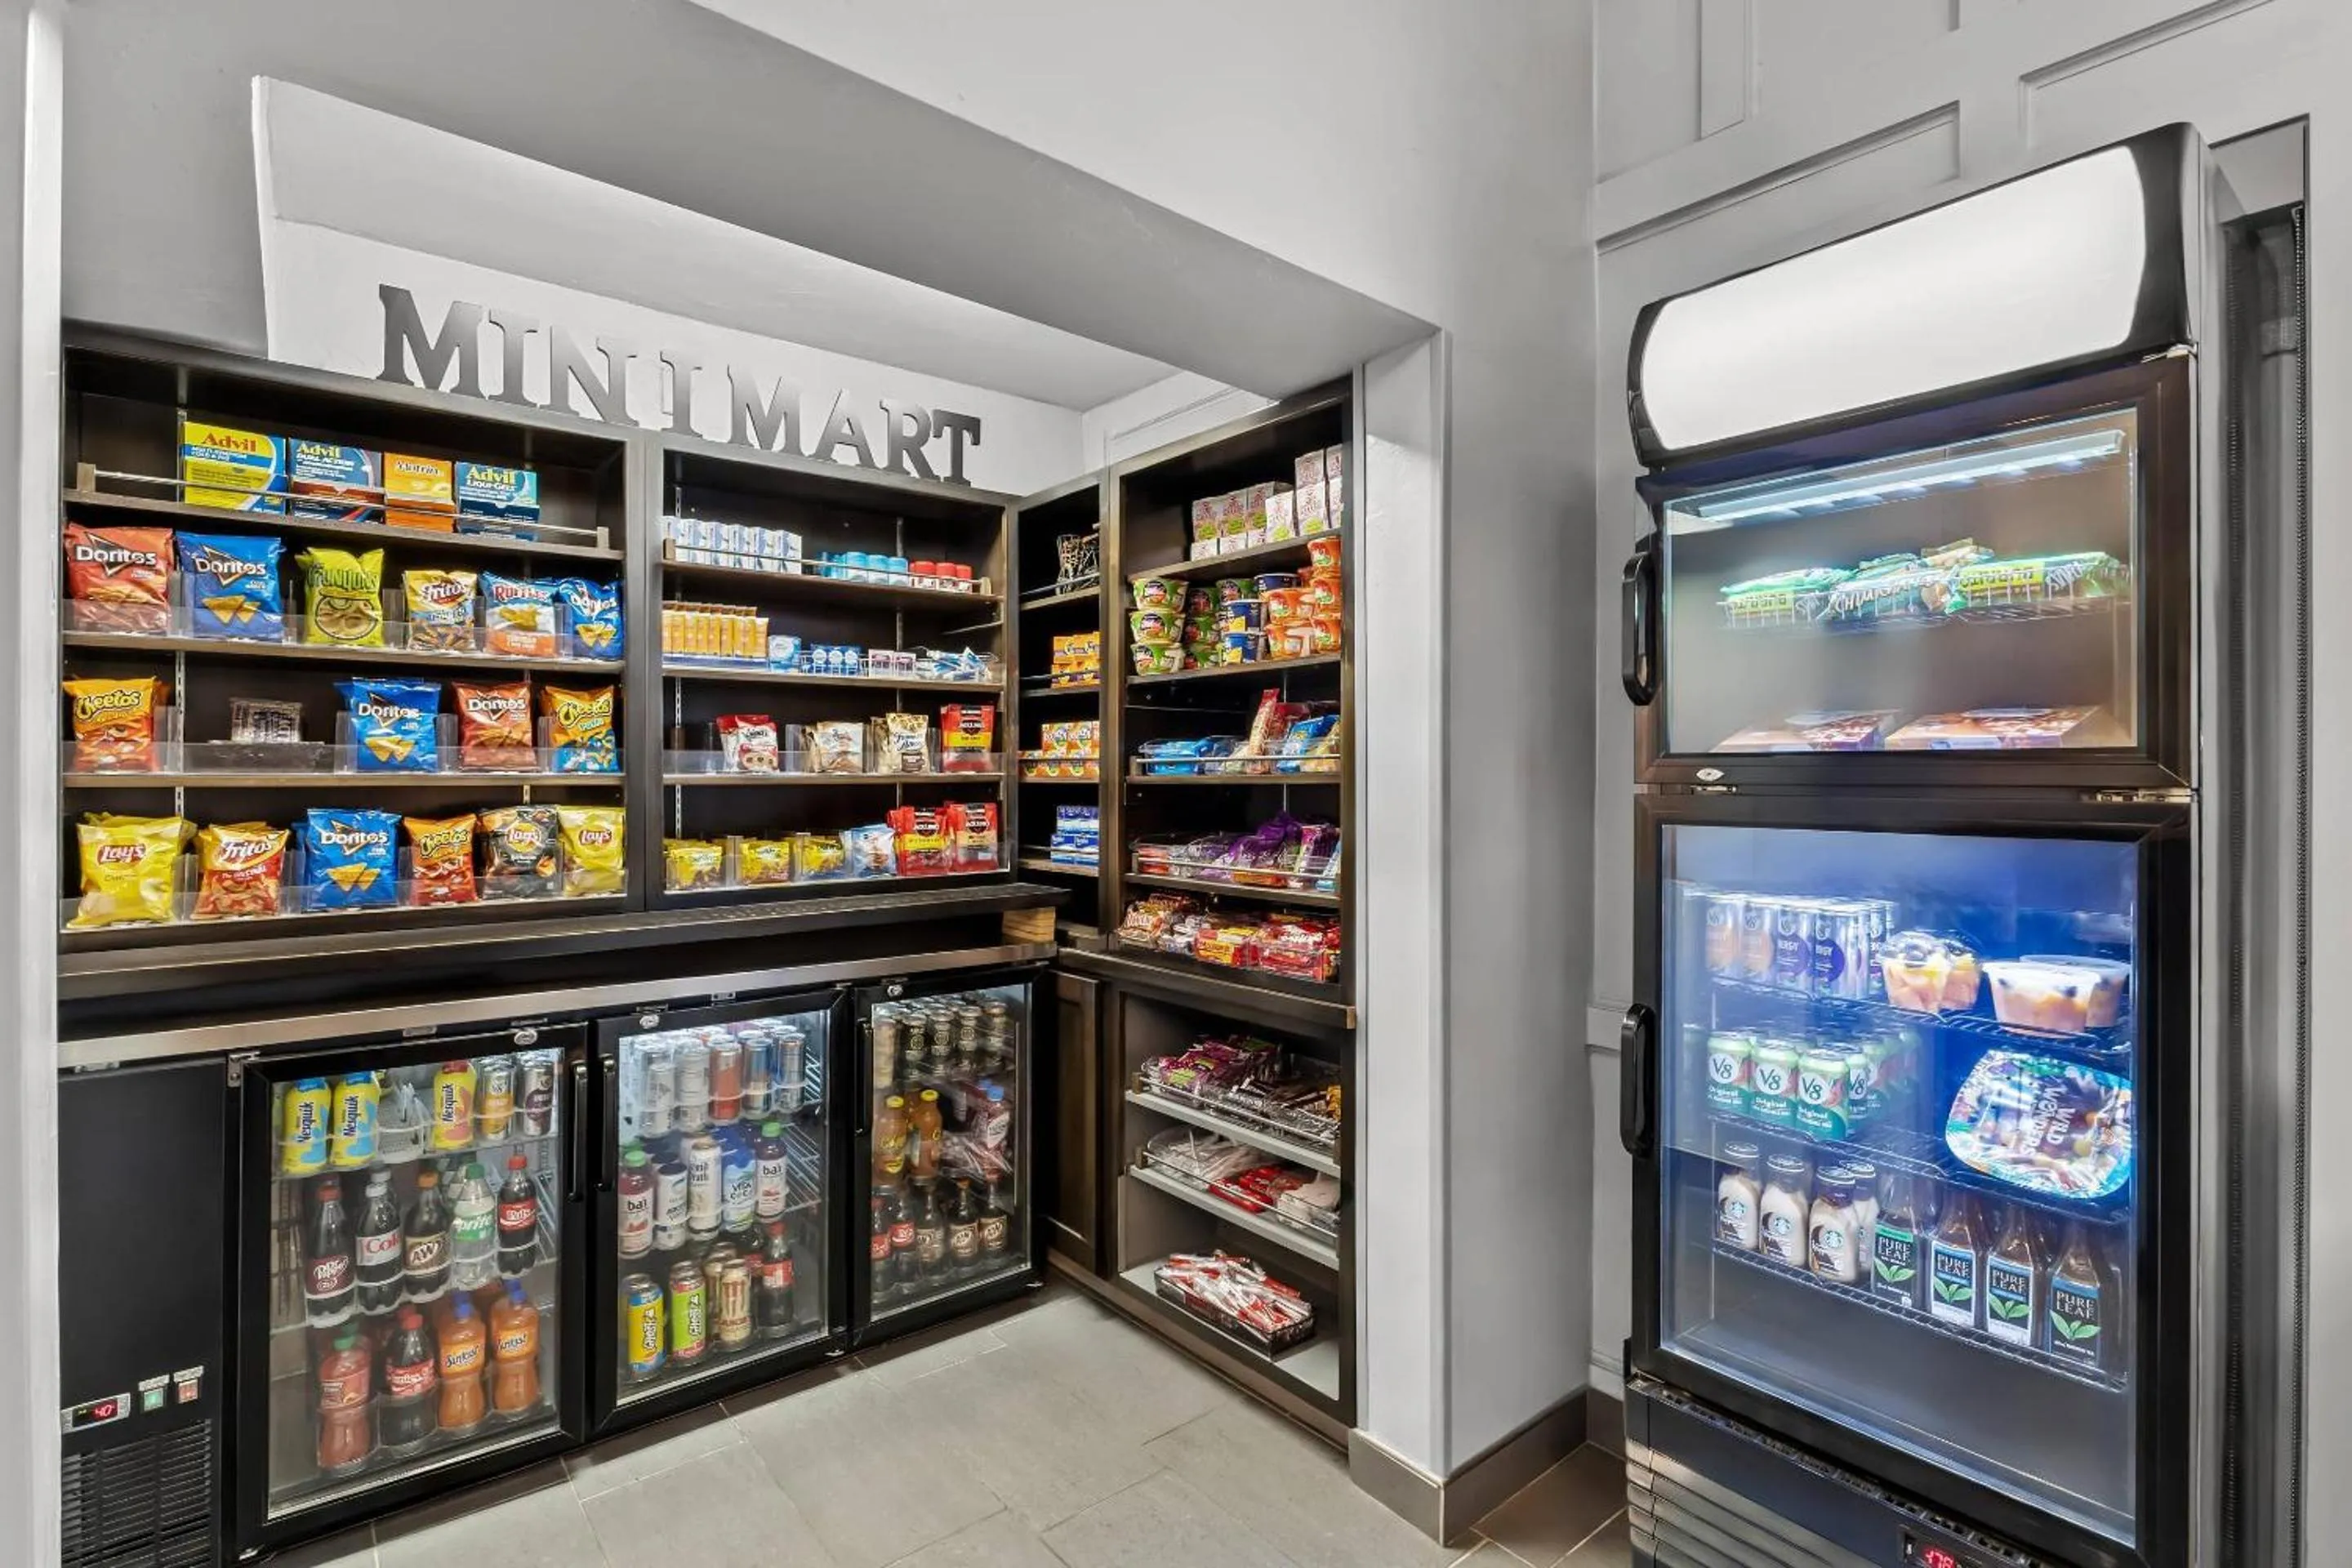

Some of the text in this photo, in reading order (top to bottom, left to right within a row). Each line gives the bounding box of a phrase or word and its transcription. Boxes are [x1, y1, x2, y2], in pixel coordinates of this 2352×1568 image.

[377, 283, 981, 487] MINI MART
[201, 432, 257, 452] Advil
[296, 442, 341, 459] Advil
[466, 465, 516, 484] Advil
[76, 545, 157, 566] Doritos
[195, 557, 266, 576] Doritos
[75, 689, 142, 719] Cheetos
[358, 702, 420, 718] Doritos
[468, 698, 527, 713] Doritos
[320, 831, 389, 844] Doritos
[420, 829, 470, 857] Cheetos
[220, 838, 272, 863] Fritos
[1713, 1058, 1732, 1079] V8
[1760, 1068, 1781, 1091] V8
[1851, 1076, 1867, 1095] V8
[1802, 1078, 1824, 1101] V8
[762, 1164, 782, 1177] bai
[626, 1198, 648, 1212] bai
[1879, 1236, 1911, 1253] PURE
[1879, 1245, 1910, 1262] LEAF
[1937, 1254, 1970, 1270] PURE
[1937, 1261, 1970, 1277] LEAF
[1992, 1269, 2025, 1285] PURE
[1992, 1277, 2026, 1294] LEAF
[2056, 1290, 2094, 1308] PURE
[2056, 1301, 2095, 1320] LEAF
